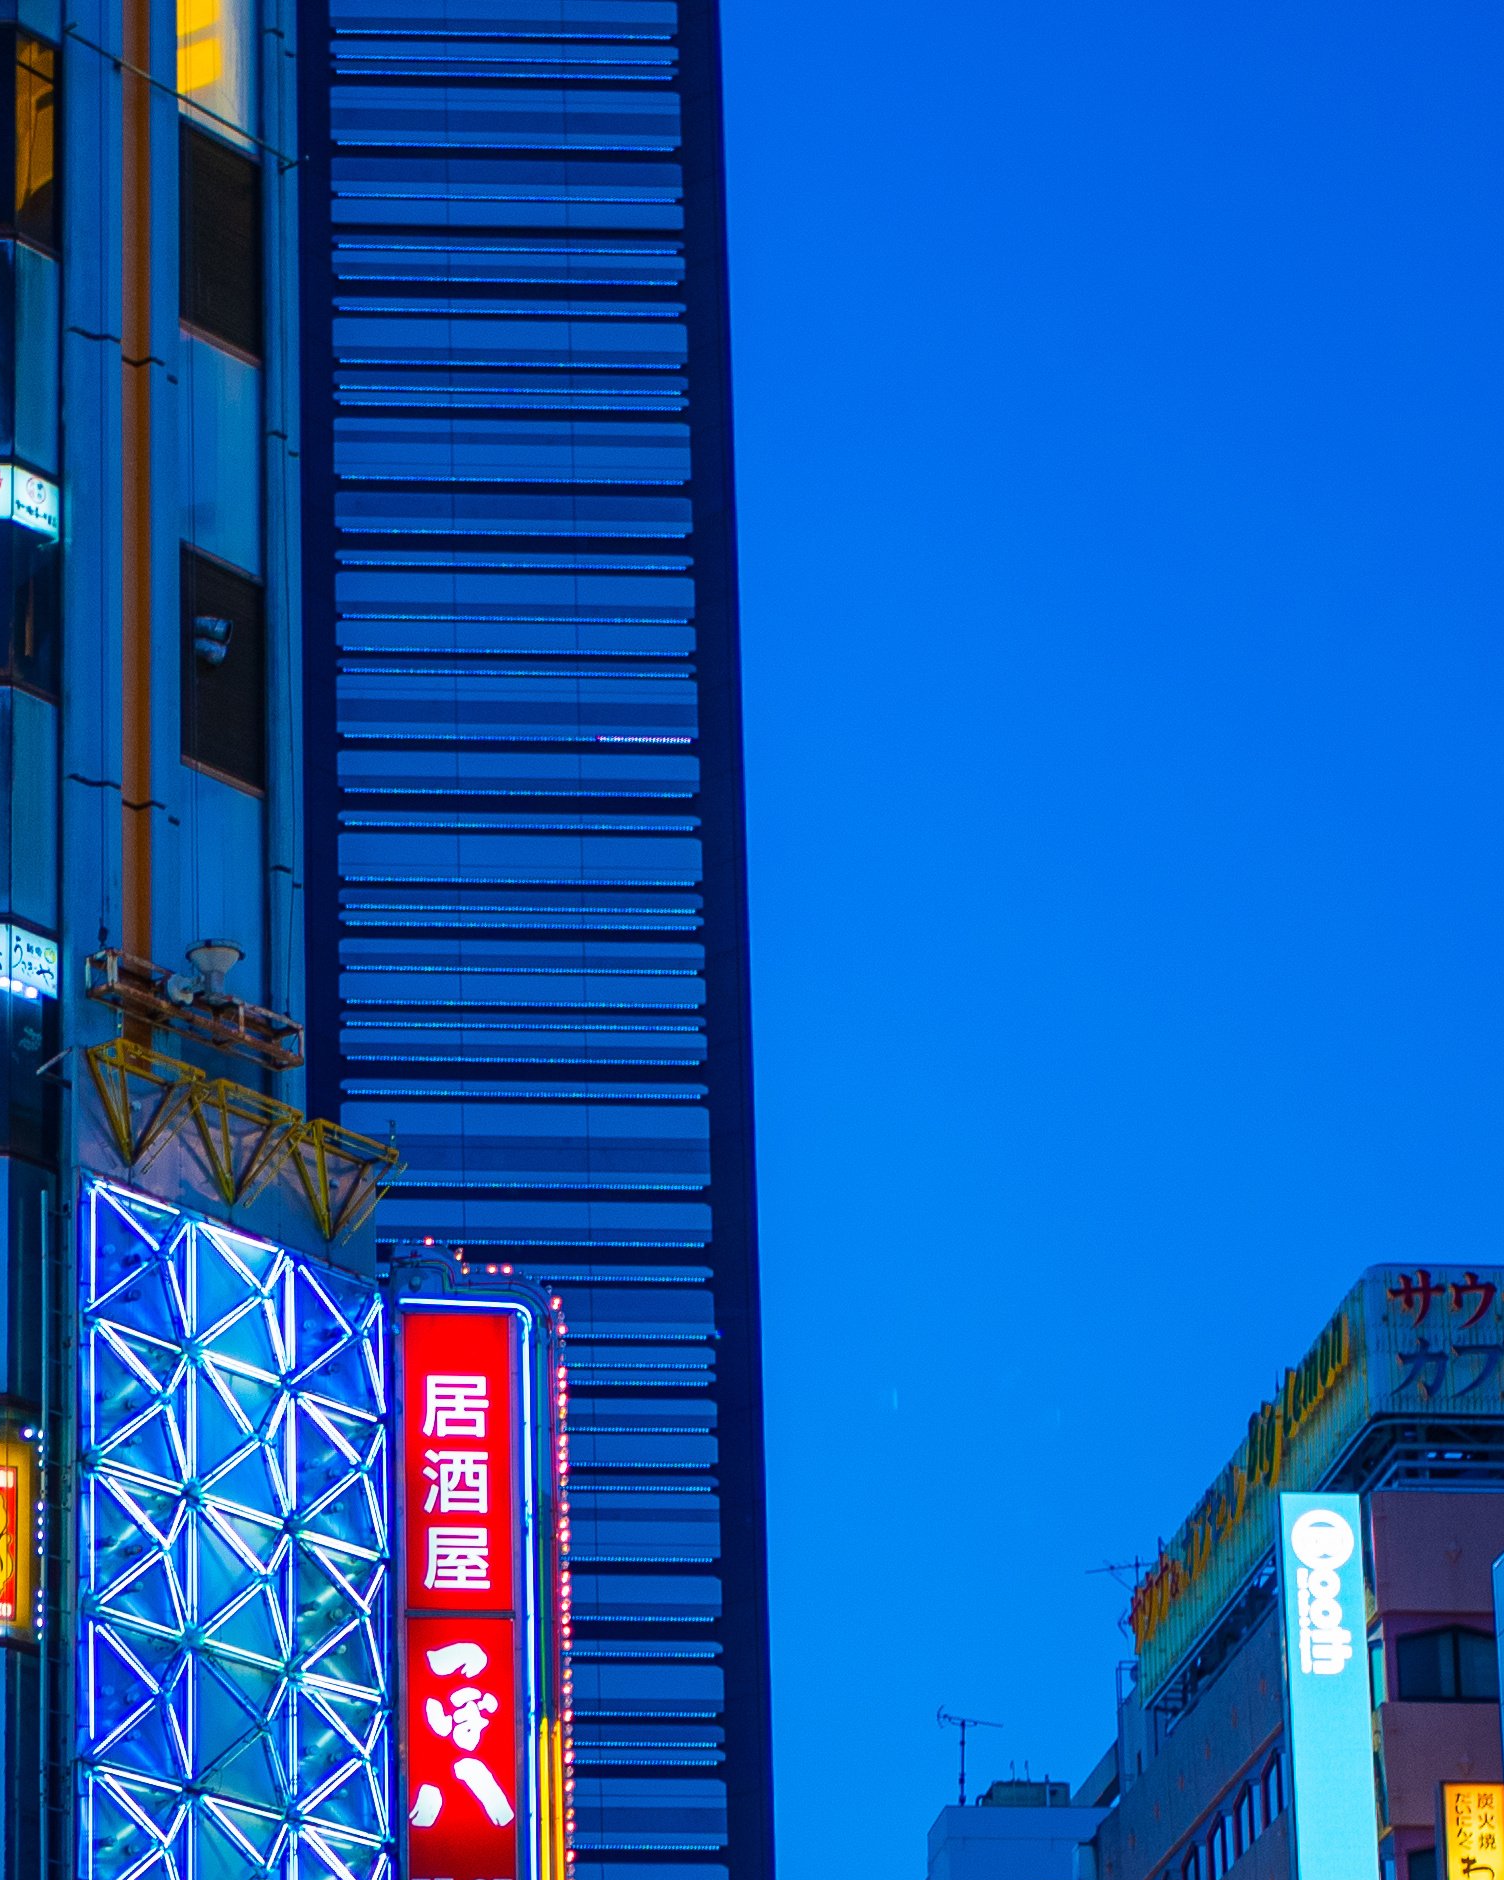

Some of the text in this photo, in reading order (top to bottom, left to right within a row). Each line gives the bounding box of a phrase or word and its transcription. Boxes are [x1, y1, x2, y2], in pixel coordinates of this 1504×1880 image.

[422, 1373, 492, 1591] 居酒屋
[408, 1640, 515, 1829] つぼ八
